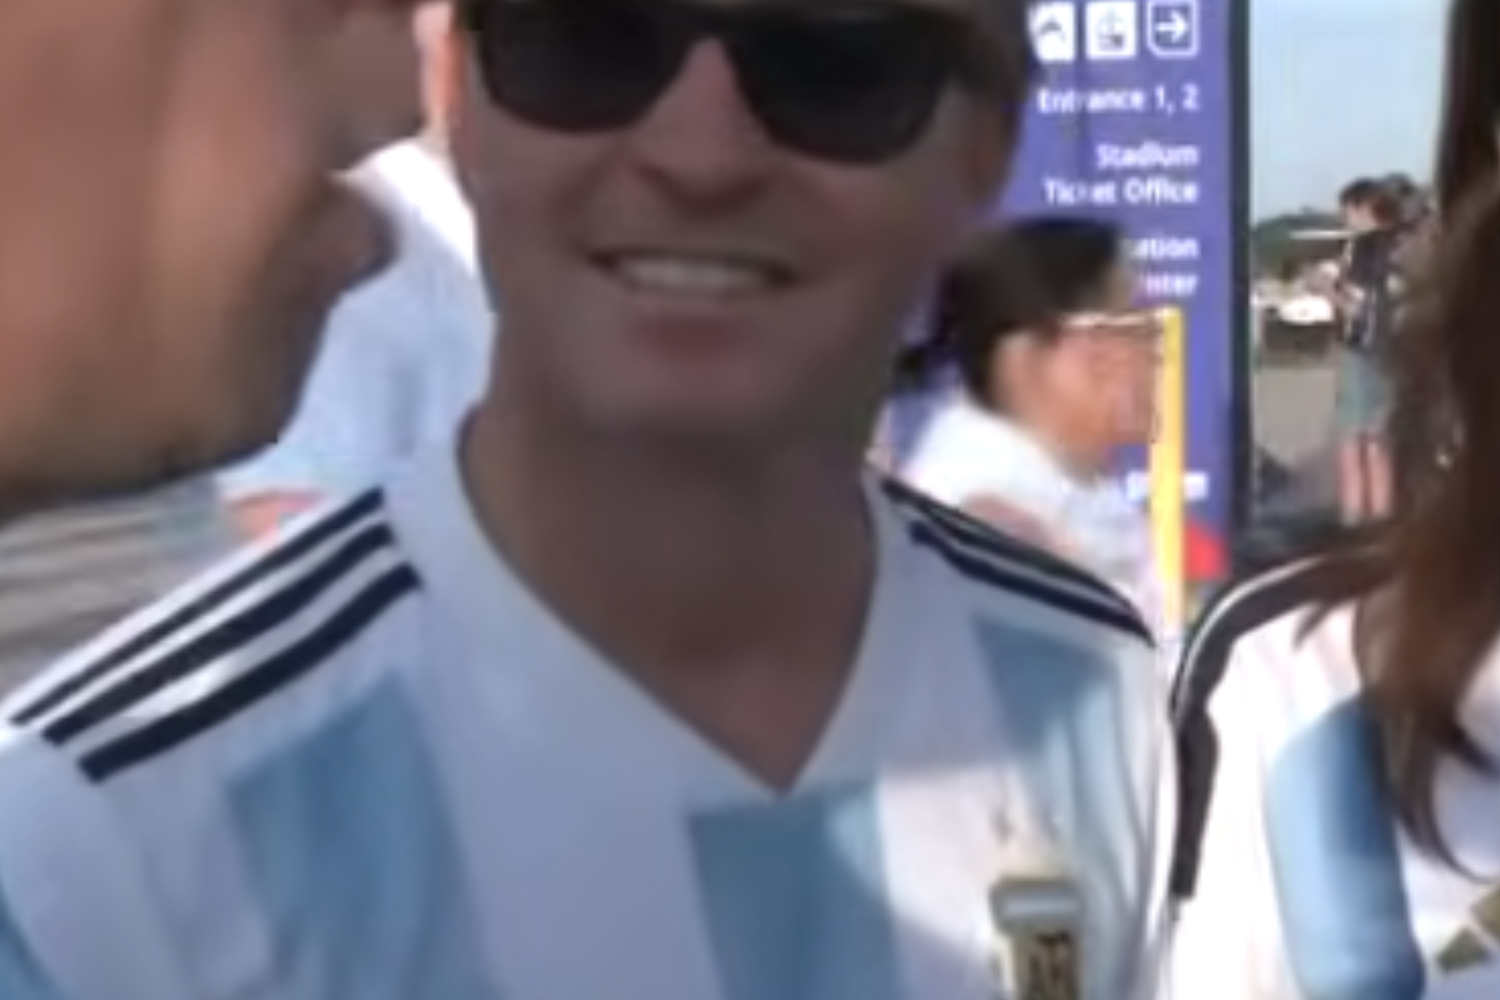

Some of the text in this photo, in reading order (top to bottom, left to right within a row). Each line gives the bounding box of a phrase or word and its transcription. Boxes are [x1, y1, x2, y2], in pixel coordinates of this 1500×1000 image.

[1182, 83, 1198, 110] 2
[1097, 142, 1198, 169] Stadium
[1124, 177, 1198, 204] Office
